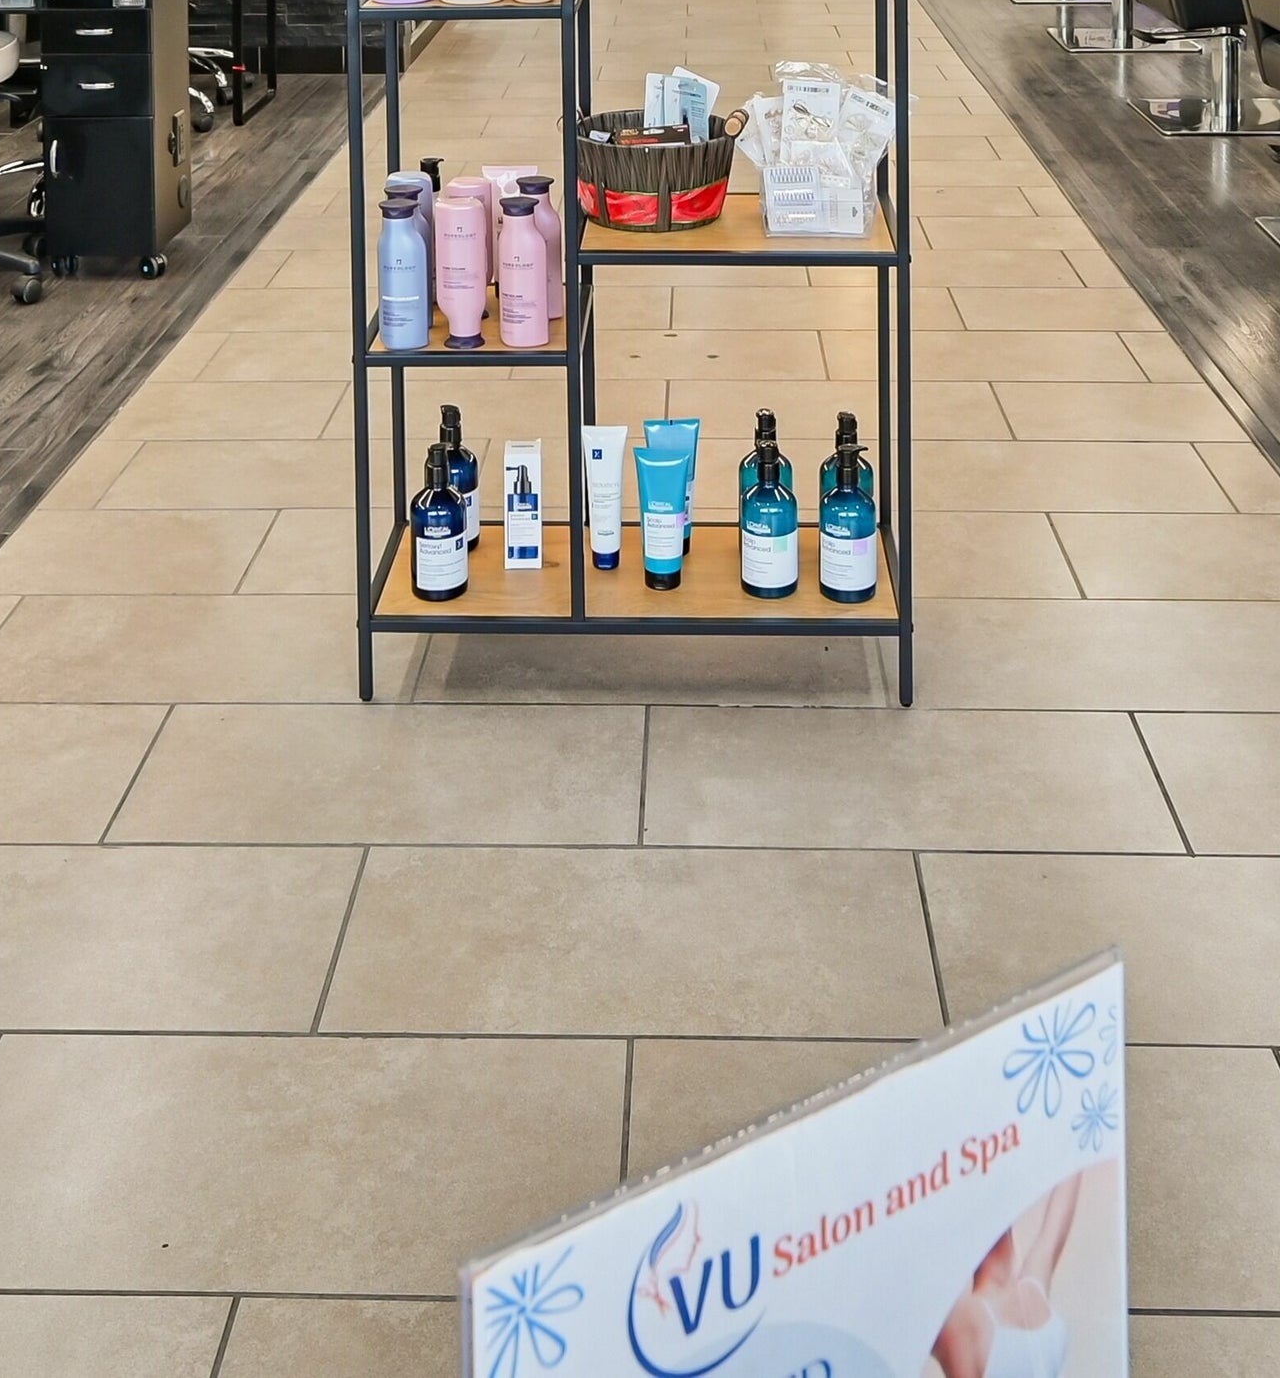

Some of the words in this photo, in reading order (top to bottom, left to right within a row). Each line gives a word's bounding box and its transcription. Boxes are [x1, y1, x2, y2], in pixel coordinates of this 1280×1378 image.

[669, 1234, 760, 1336] VU
[773, 1199, 874, 1278] Salon
[886, 1152, 950, 1212] and
[958, 1121, 1020, 1177] Spa
